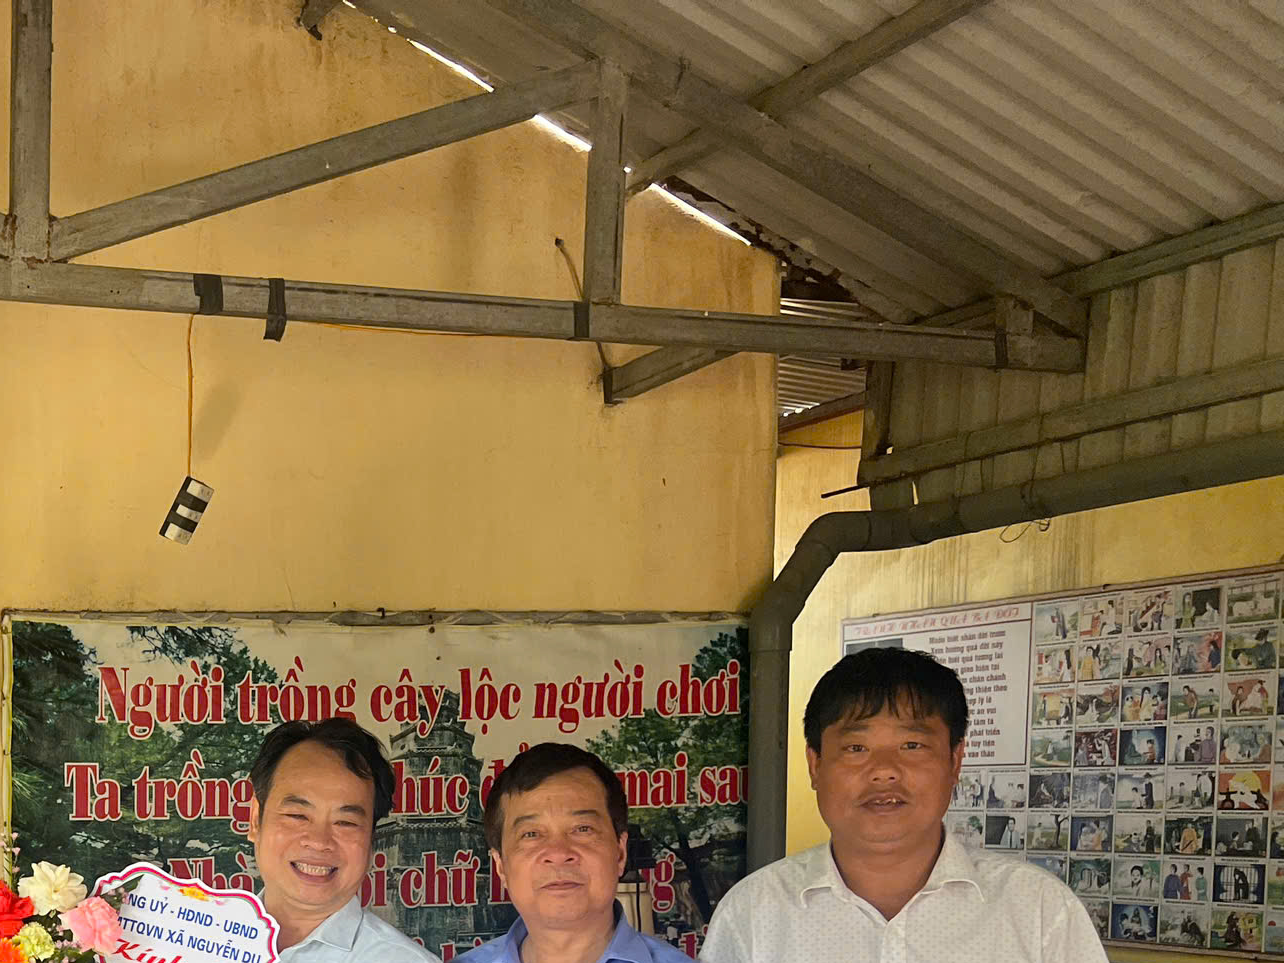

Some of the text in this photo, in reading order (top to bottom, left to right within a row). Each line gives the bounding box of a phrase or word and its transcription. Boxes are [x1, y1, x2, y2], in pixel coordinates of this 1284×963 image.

[97, 656, 741, 739] Người trồng cây lộc người chơi
[65, 762, 122, 821] Ta
[133, 749, 254, 834] trồng
[391, 756, 469, 815] húc
[615, 751, 688, 808] mai
[399, 849, 480, 908] chữ
[128, 893, 147, 909] NG
[177, 907, 214, 927] HĐND
[223, 919, 259, 940] UBND
[165, 929, 185, 946] XÃ
[187, 935, 242, 961] NGUYỄN
